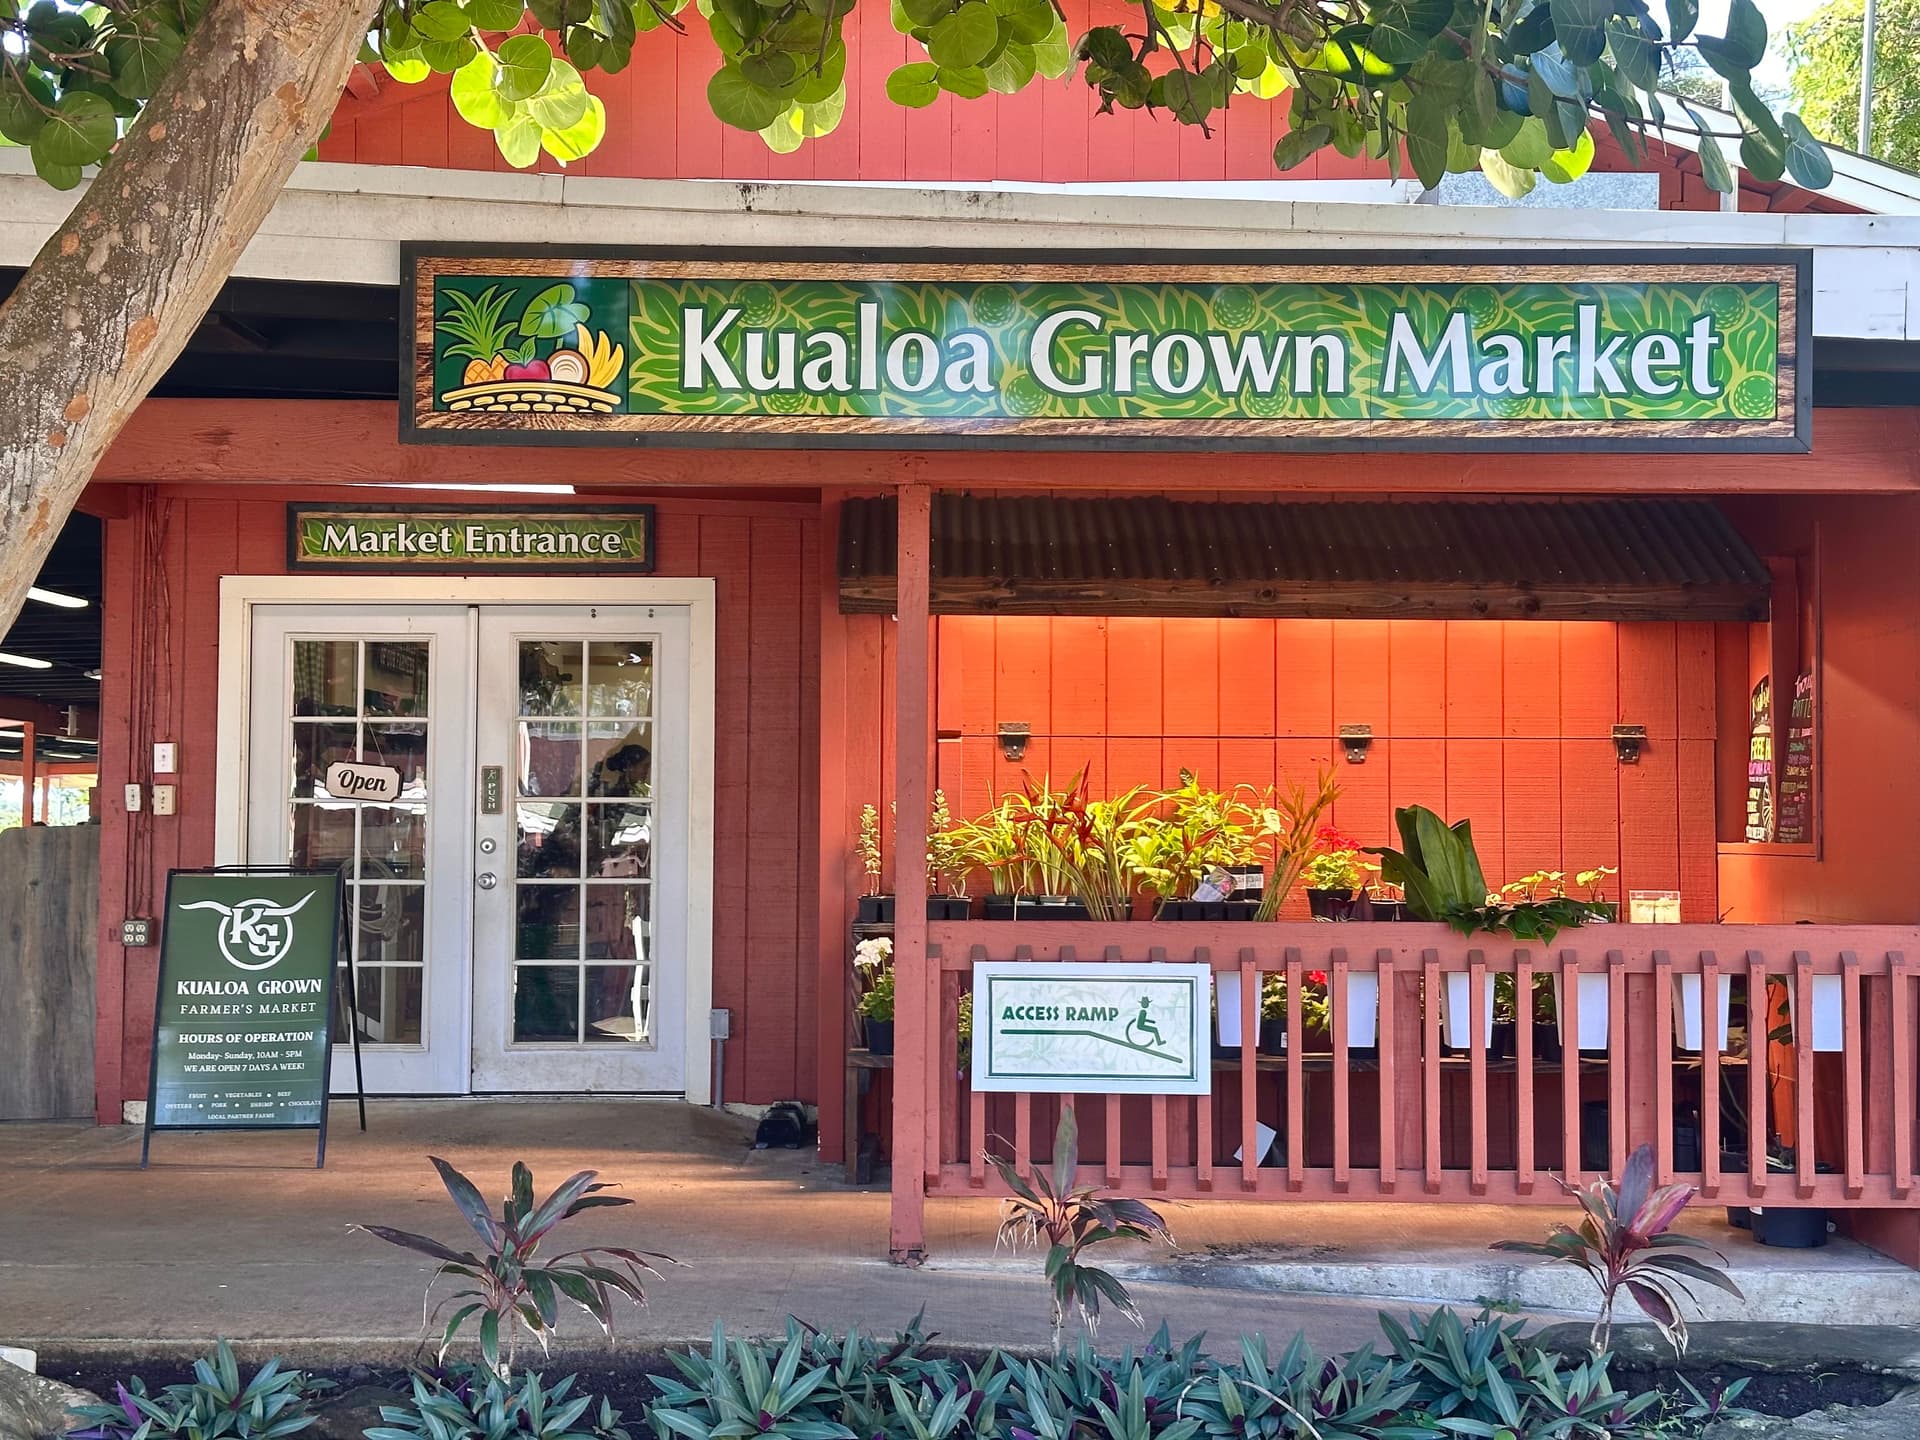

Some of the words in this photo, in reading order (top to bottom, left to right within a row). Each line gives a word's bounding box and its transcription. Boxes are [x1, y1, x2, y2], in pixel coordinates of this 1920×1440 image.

[680, 301, 995, 393] Kualoa
[1030, 310, 1346, 395] Grown
[1382, 303, 1720, 396] Market
[322, 523, 453, 553] Market
[465, 525, 622, 554] Entrance
[337, 768, 388, 795] Open
[487, 782, 496, 809] PUSH
[176, 980, 249, 996] KUALOA
[257, 979, 322, 995] GROWN
[180, 1004, 254, 1015] FARMER'S
[260, 1002, 317, 1014] MARKET
[1001, 1006, 1060, 1021] ACCESS
[1066, 1006, 1119, 1022] RAMP
[178, 1033, 223, 1044] HOURS
[225, 1033, 243, 1043] OF
[244, 1031, 314, 1043] OPERATION
[256, 1051, 279, 1059] 10AM
[285, 1050, 303, 1058] 5PM
[199, 1064, 217, 1072] ARE
[218, 1064, 241, 1072] OPEN
[241, 1064, 247, 1072] 7
[249, 1063, 271, 1072] DAYS
[271, 1063, 278, 1071] A
